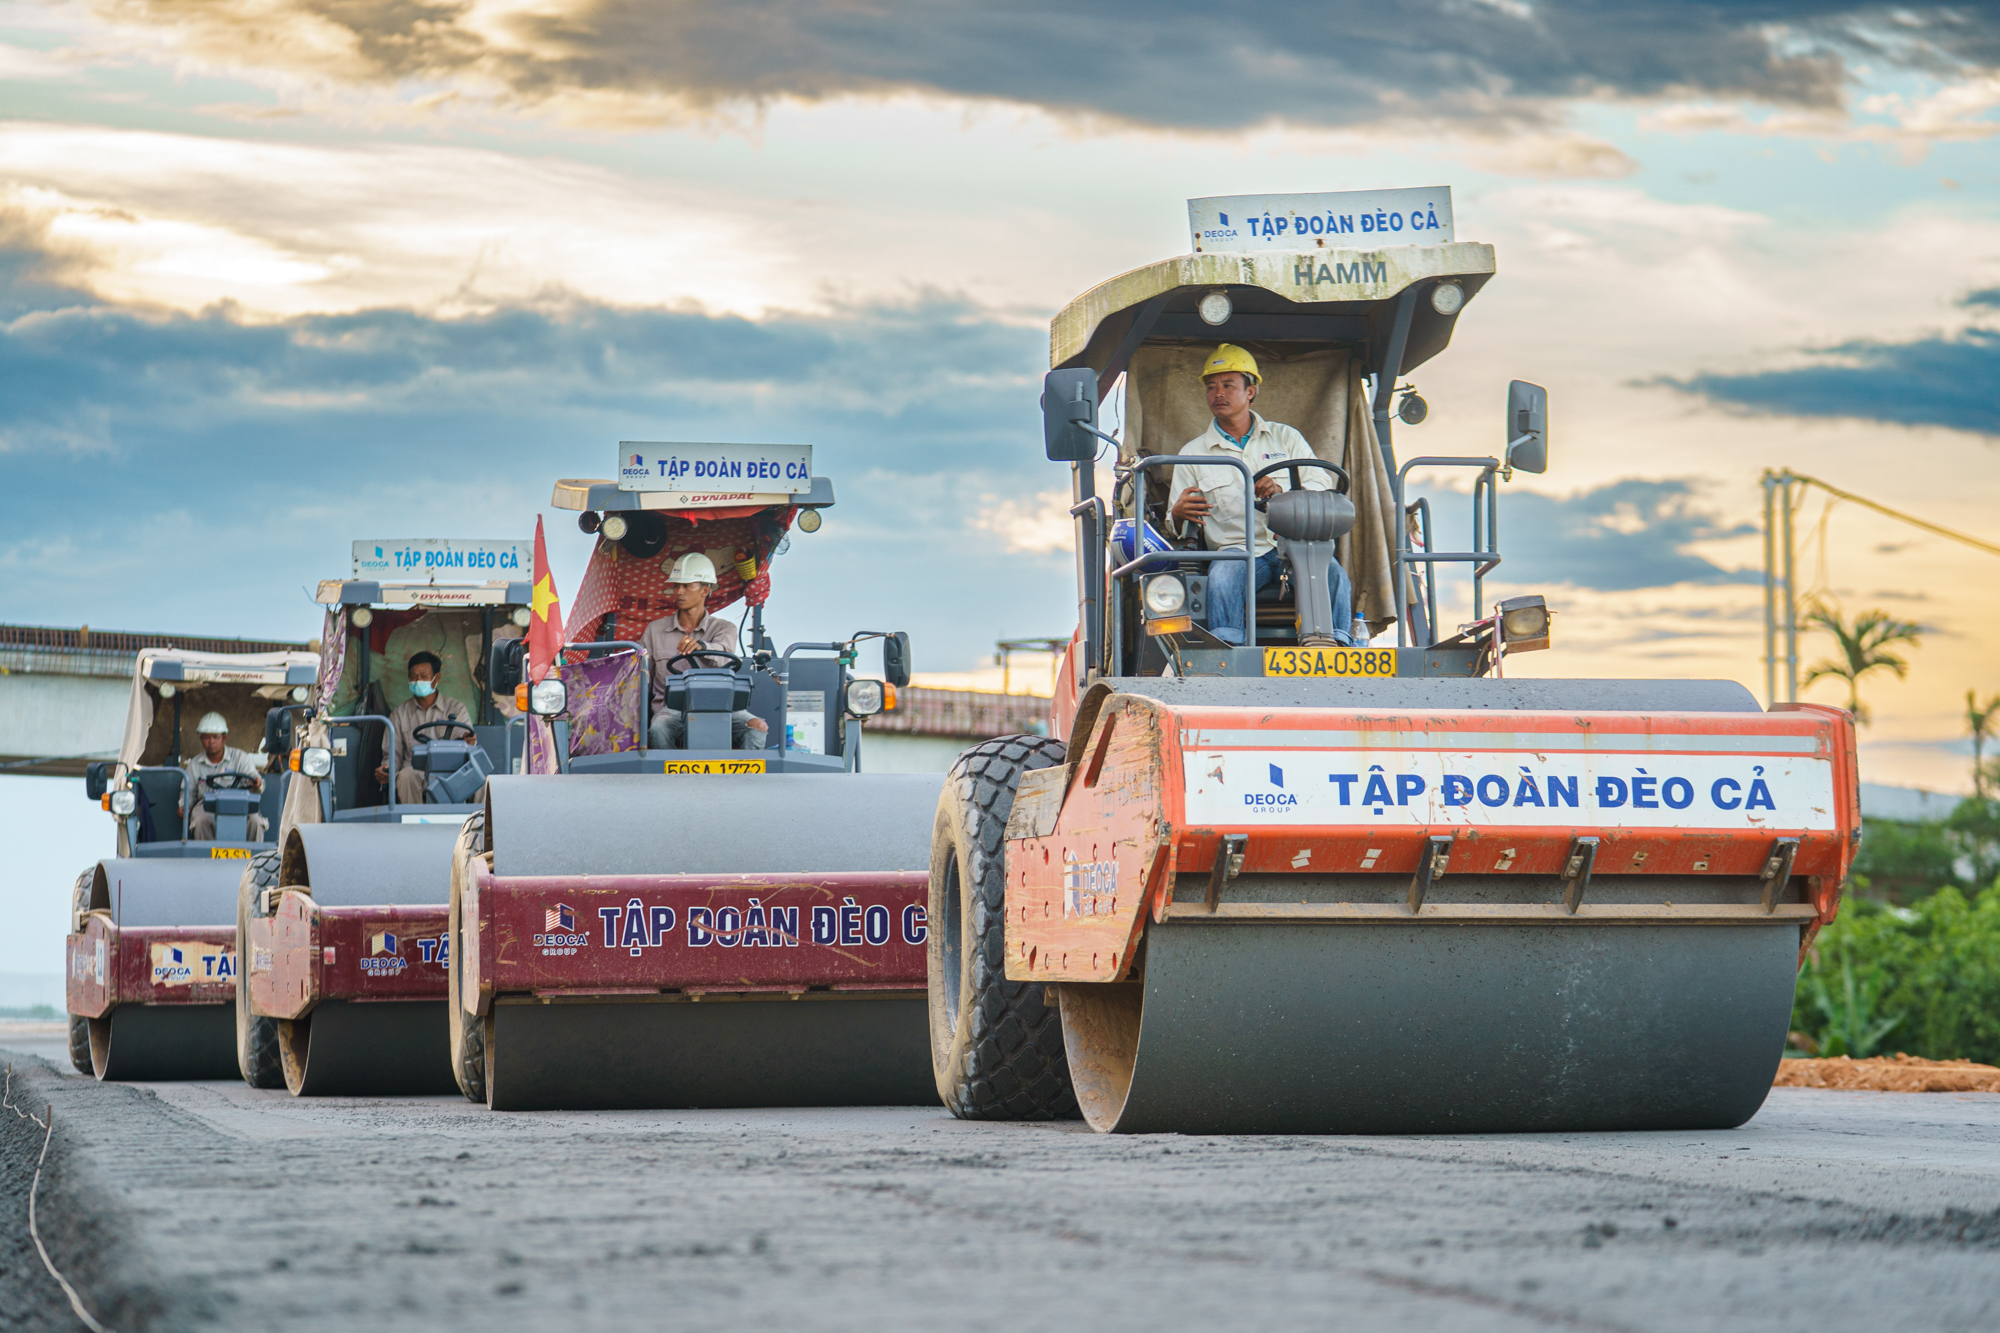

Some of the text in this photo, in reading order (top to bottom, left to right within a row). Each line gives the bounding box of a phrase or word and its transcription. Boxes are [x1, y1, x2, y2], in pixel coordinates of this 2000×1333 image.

[1204, 229, 1238, 238] DEOCA
[1247, 202, 1440, 242] TẬP ĐOÀN ĐÈO CẢ
[1294, 261, 1387, 286] HAMM
[658, 456, 809, 480] TẬP ĐOÀN ĐÈO CẢ
[691, 493, 755, 502] DYNAPAC
[394, 545, 519, 572] TẬP ĐOÀN ĐÈO CẢ
[1268, 651, 1392, 675] 43SA-0388
[1244, 793, 1298, 806] DEOCA
[1329, 764, 1777, 815] TẬP ĐOÀN ĐÈO CẢ
[1082, 860, 1117, 899] DEOCA
[598, 897, 676, 957] TẬP
[687, 898, 799, 948] ĐOÀN
[811, 897, 890, 946] ĐÈO
[902, 904, 928, 945] C
[417, 931, 449, 969] TẬ
[533, 934, 588, 947] DEOCA
[542, 948, 577, 956] GROUP
[154, 967, 192, 976] DEOCA
[202, 951, 236, 982] TẬ
[360, 956, 408, 969] DEOCA
